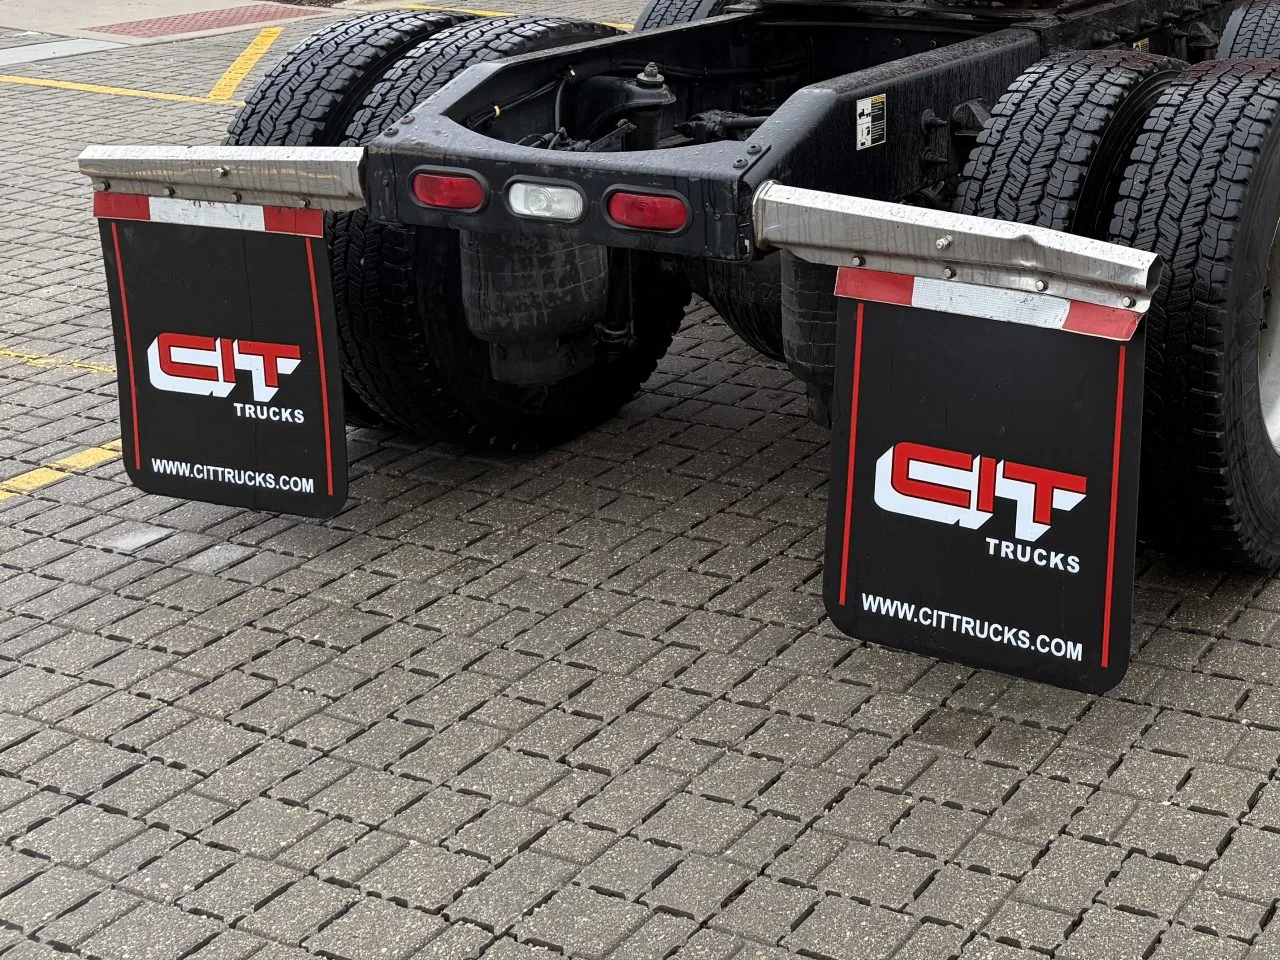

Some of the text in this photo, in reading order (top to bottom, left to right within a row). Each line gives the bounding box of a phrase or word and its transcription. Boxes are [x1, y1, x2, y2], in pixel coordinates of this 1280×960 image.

[147, 333, 302, 402] CIT
[234, 402, 305, 423] TRUCKS
[152, 458, 314, 493] WWW.CITTRUCKS.COM
[874, 441, 1087, 542] CIT
[986, 537, 1081, 574] TRUCKS
[862, 593, 1083, 662] WWW.CITTRUCKS.COM
